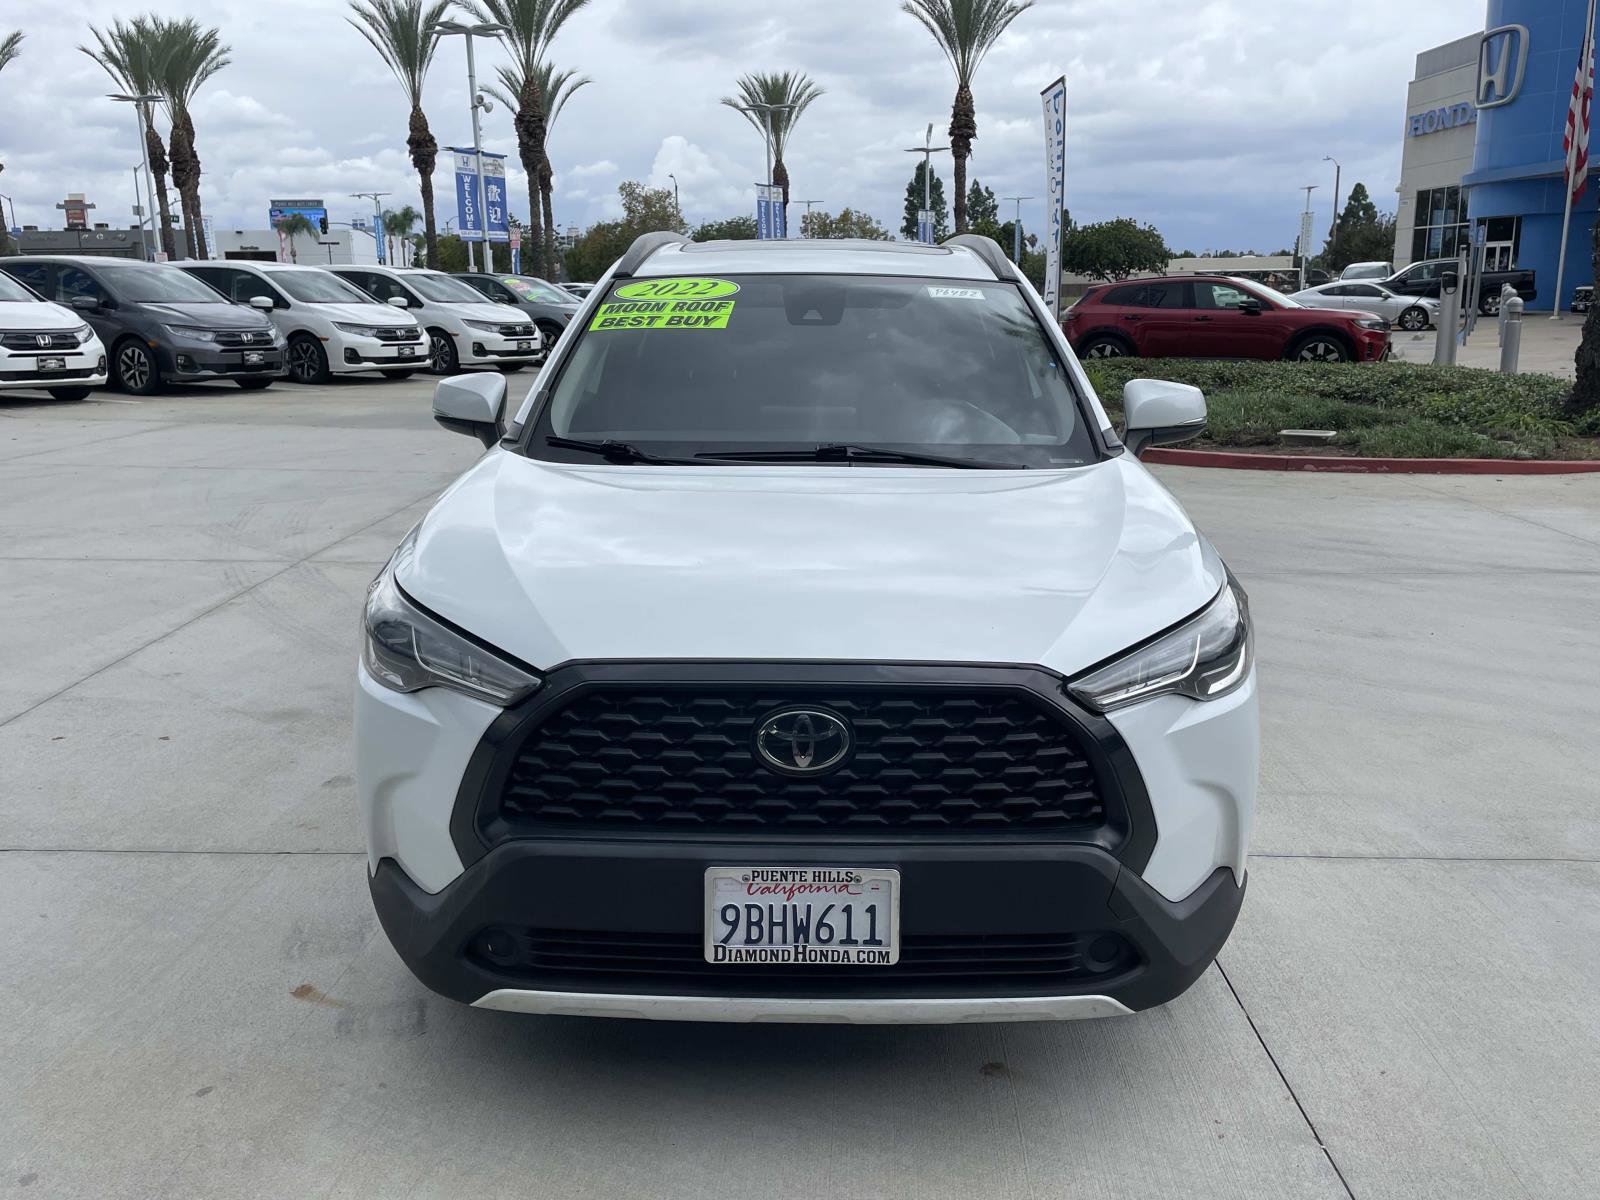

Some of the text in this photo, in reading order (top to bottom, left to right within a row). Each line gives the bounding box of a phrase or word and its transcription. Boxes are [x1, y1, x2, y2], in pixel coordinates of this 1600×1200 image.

[462, 175, 473, 229] WELCOME
[634, 283, 719, 296] 2022
[602, 300, 732, 315] MOON ROOF
[598, 315, 721, 328] BEST BUY
[751, 870, 854, 883] PUENTE HILLS
[747, 882, 862, 902] California
[719, 903, 883, 945] 9BHW611
